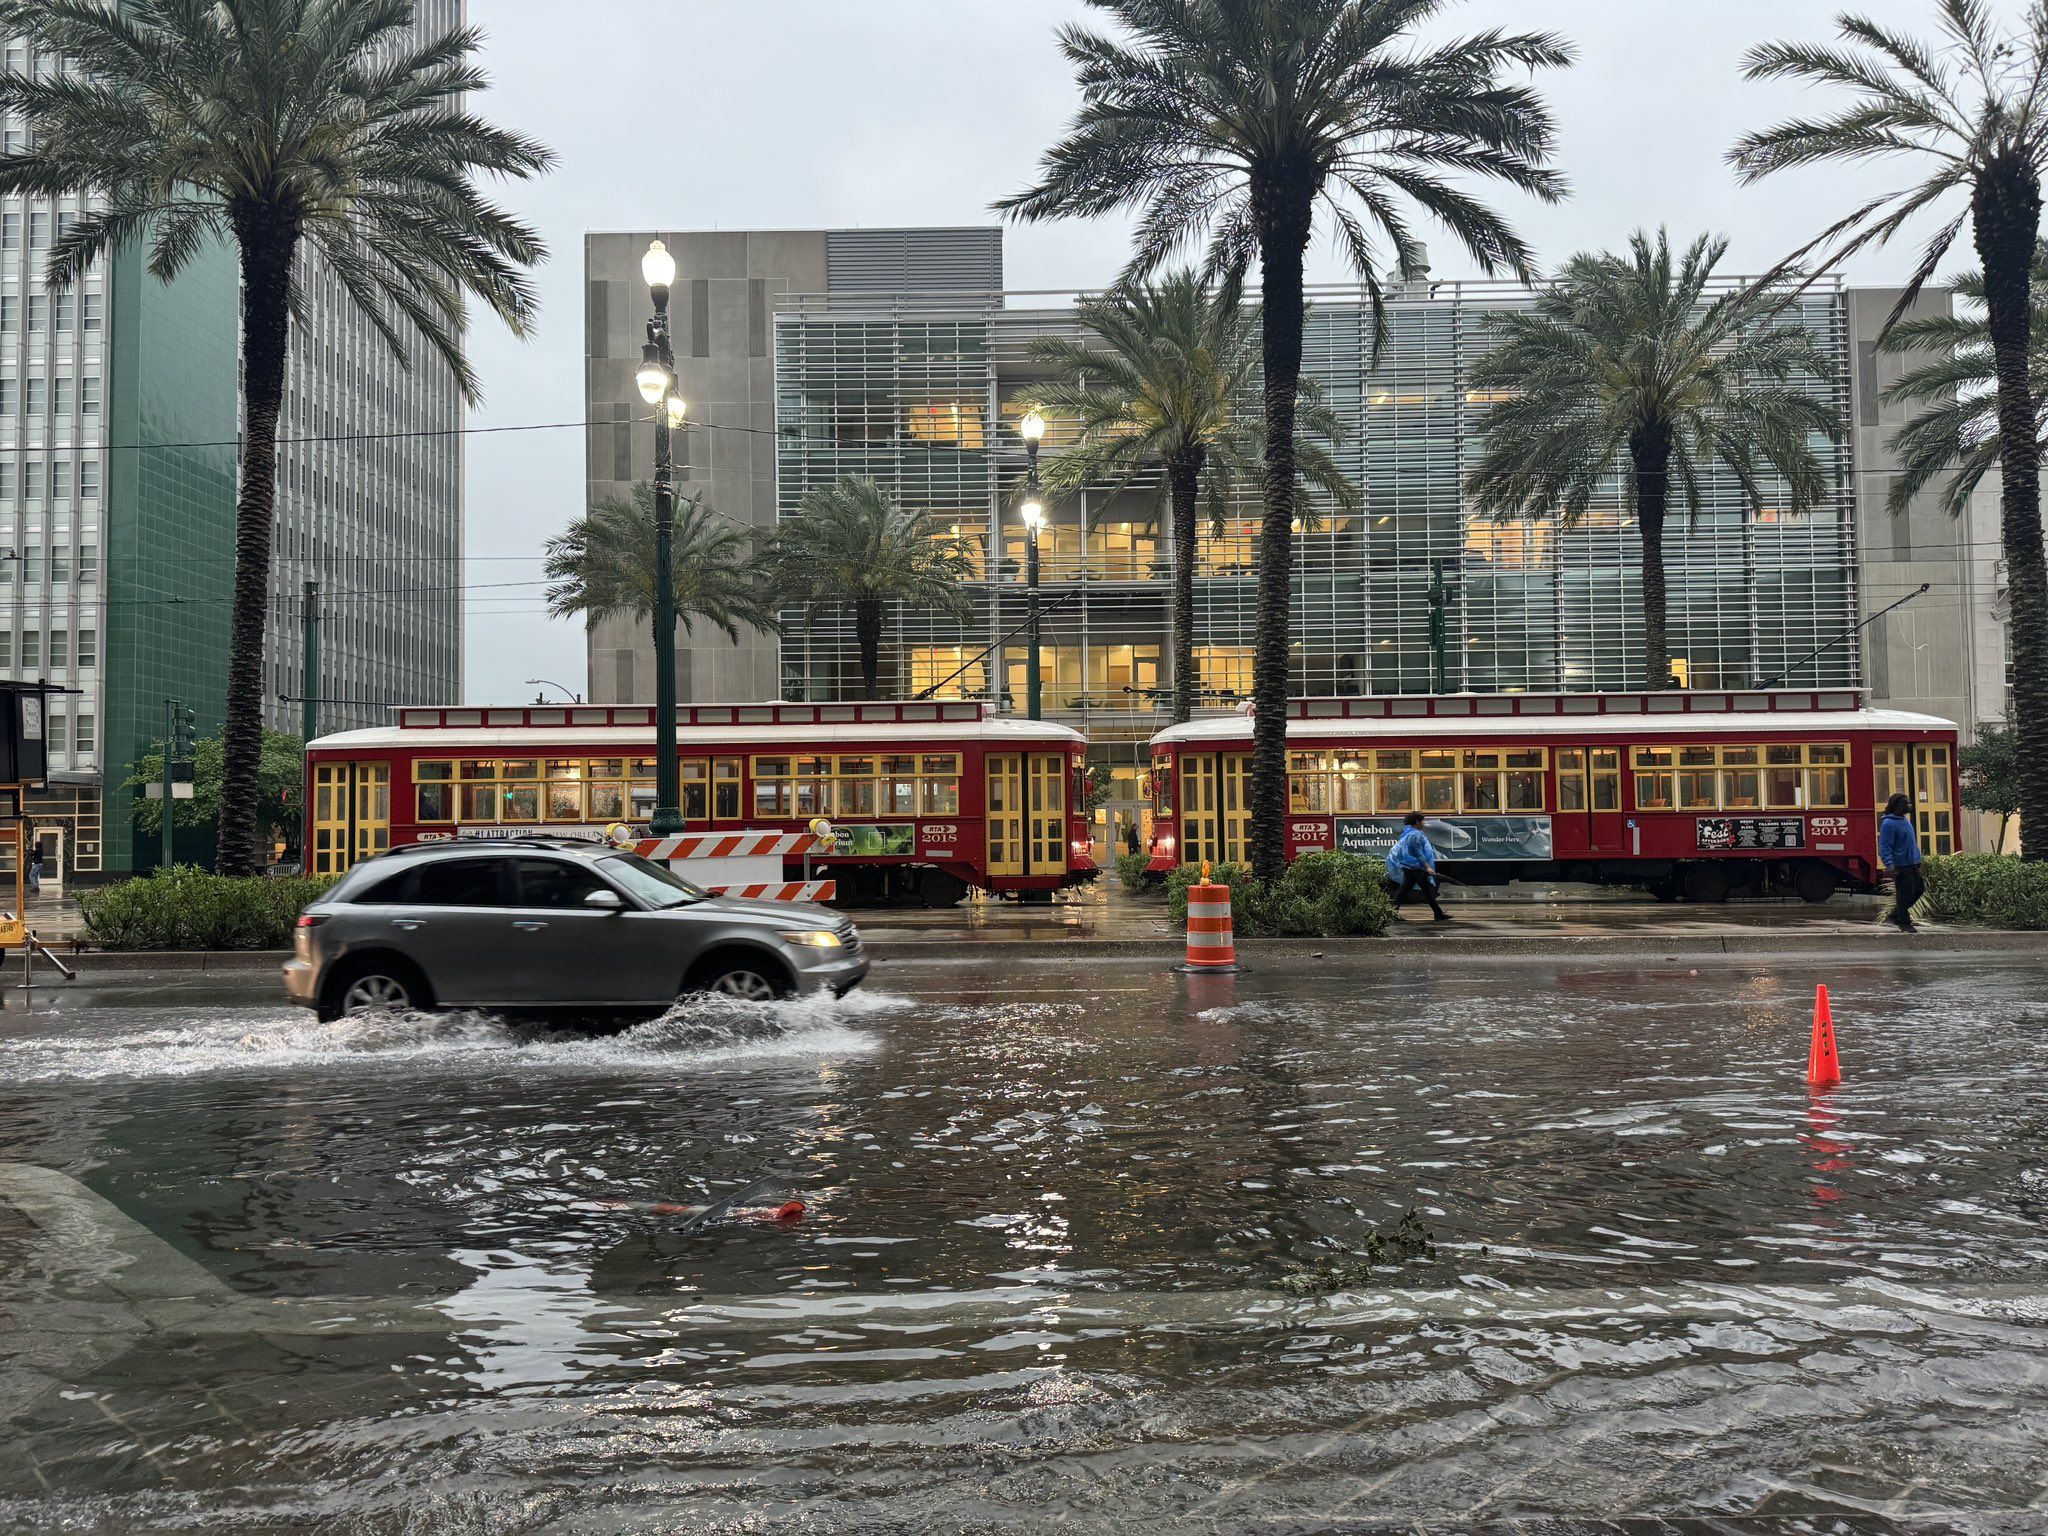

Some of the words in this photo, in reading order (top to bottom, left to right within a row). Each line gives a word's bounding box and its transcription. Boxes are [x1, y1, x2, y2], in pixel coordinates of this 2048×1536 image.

[1342, 825, 1393, 834] Audubon
[1811, 827, 1848, 836] 2017
[922, 834, 957, 843] 2018
[1292, 832, 1328, 841] 2017
[1342, 837, 1398, 849] Aquarium
